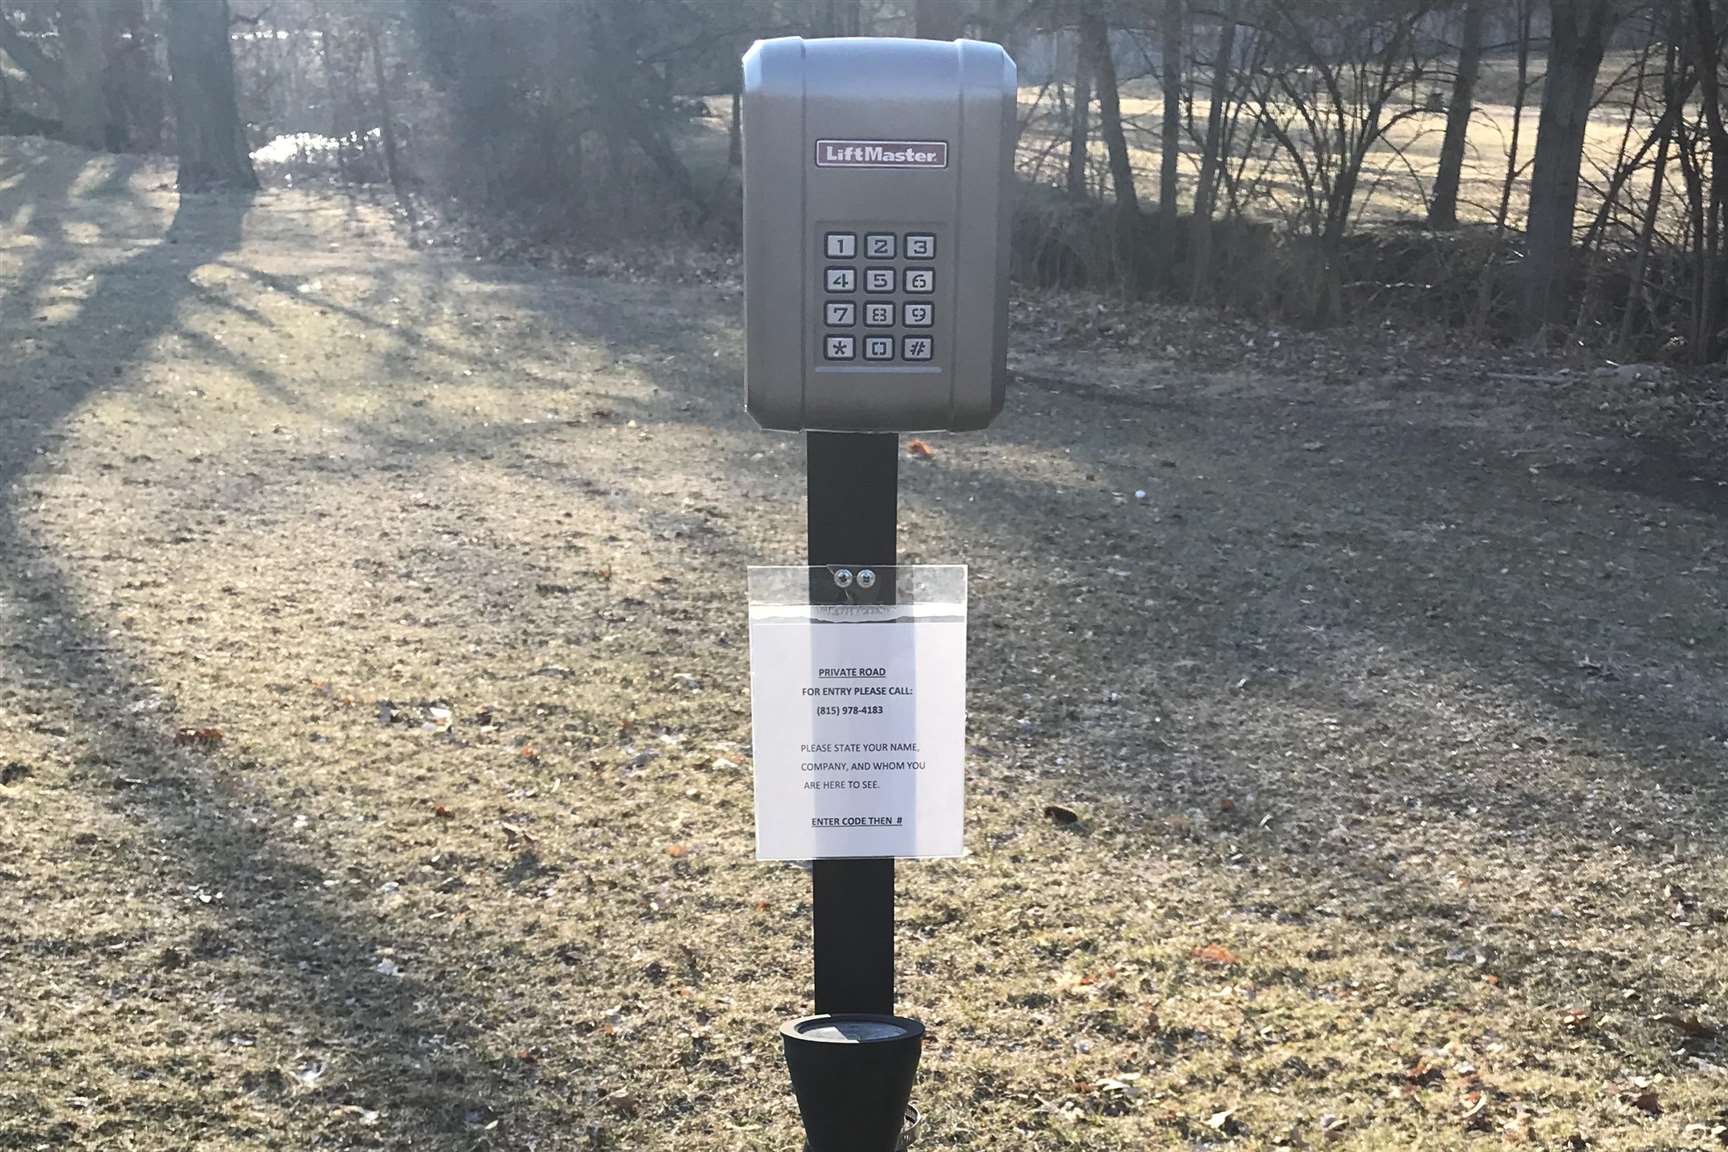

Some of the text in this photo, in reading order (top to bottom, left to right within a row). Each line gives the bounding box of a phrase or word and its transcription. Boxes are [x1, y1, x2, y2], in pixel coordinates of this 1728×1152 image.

[826, 145, 937, 162] LiftMaster
[837, 239, 927, 254] 1 2 3
[833, 273, 926, 288] 4 5 6
[833, 308, 925, 322] 7 8 9
[818, 668, 886, 678] PRIVATE ROAD
[802, 686, 913, 696] FOR ENTRY PLEASE CALL:
[816, 706, 883, 716] (815) 978-4183
[801, 744, 832, 752] PLEASE
[834, 743, 861, 752] STATE
[863, 743, 888, 752] YOUR
[801, 761, 926, 772] COMPANY, AND WHOM YOU
[803, 781, 821, 789] ARE
[823, 781, 846, 789] HERE
[848, 780, 860, 789] TO
[811, 816, 903, 827] ENTER CODE THEN #
